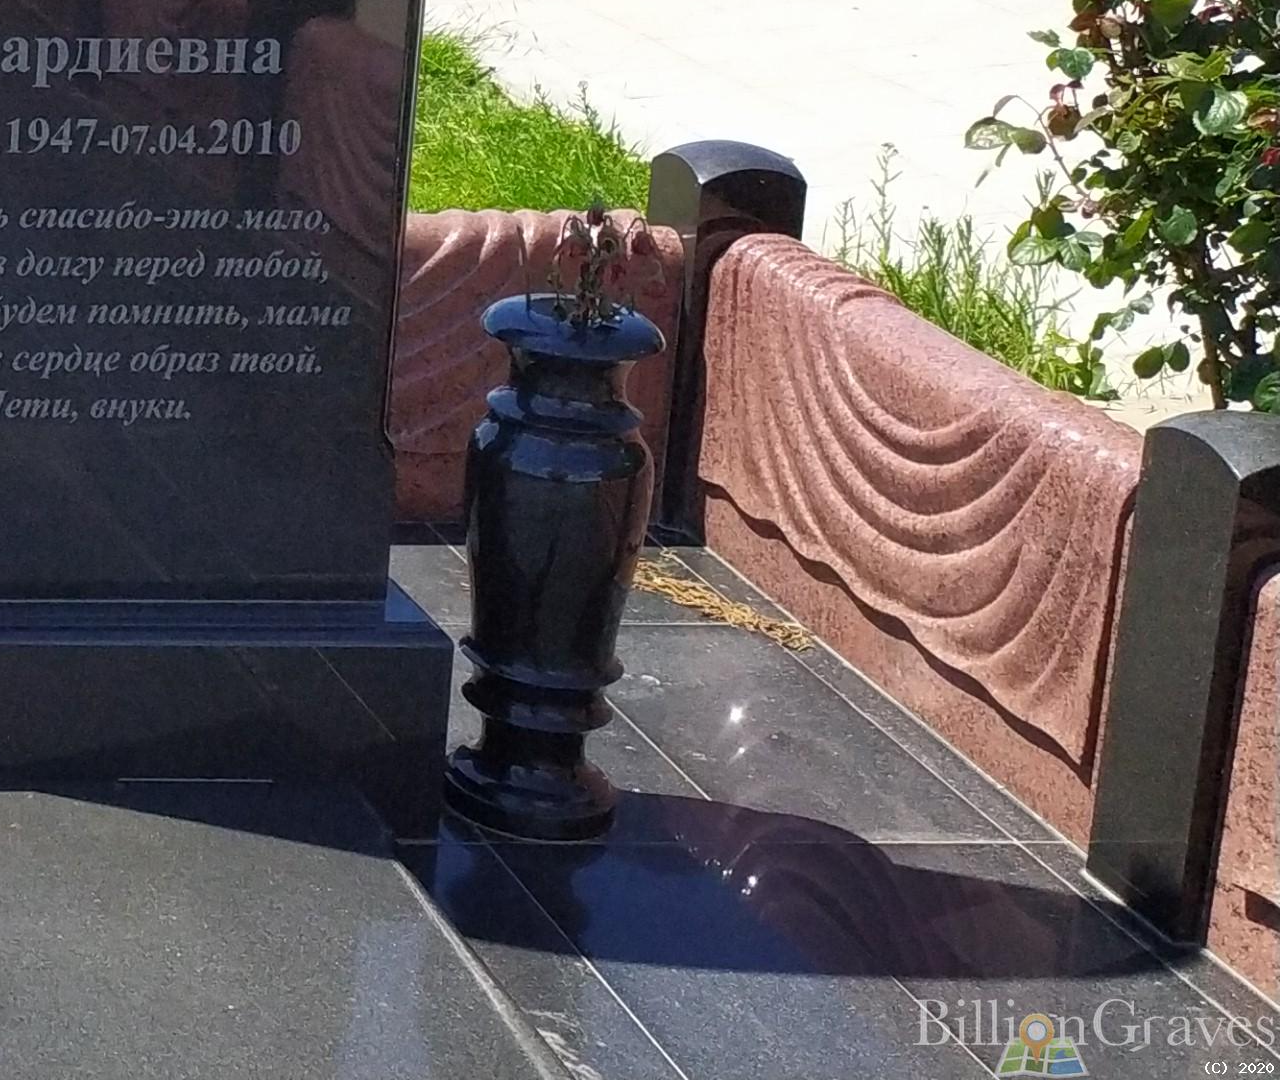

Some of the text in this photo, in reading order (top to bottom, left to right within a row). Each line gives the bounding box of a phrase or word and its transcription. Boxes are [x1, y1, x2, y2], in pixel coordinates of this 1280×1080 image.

[19, 202, 229, 230] спасибо-это
[236, 208, 331, 233] мало,
[17, 248, 105, 284] долгу
[113, 249, 206, 284] перед
[214, 251, 329, 282] тобой,
[87, 304, 250, 329] помнить,
[258, 304, 351, 326] мама
[12, 344, 121, 379] сердце
[130, 345, 220, 379] образ
[230, 346, 323, 375] твой.
[90, 400, 192, 426] внуки.
